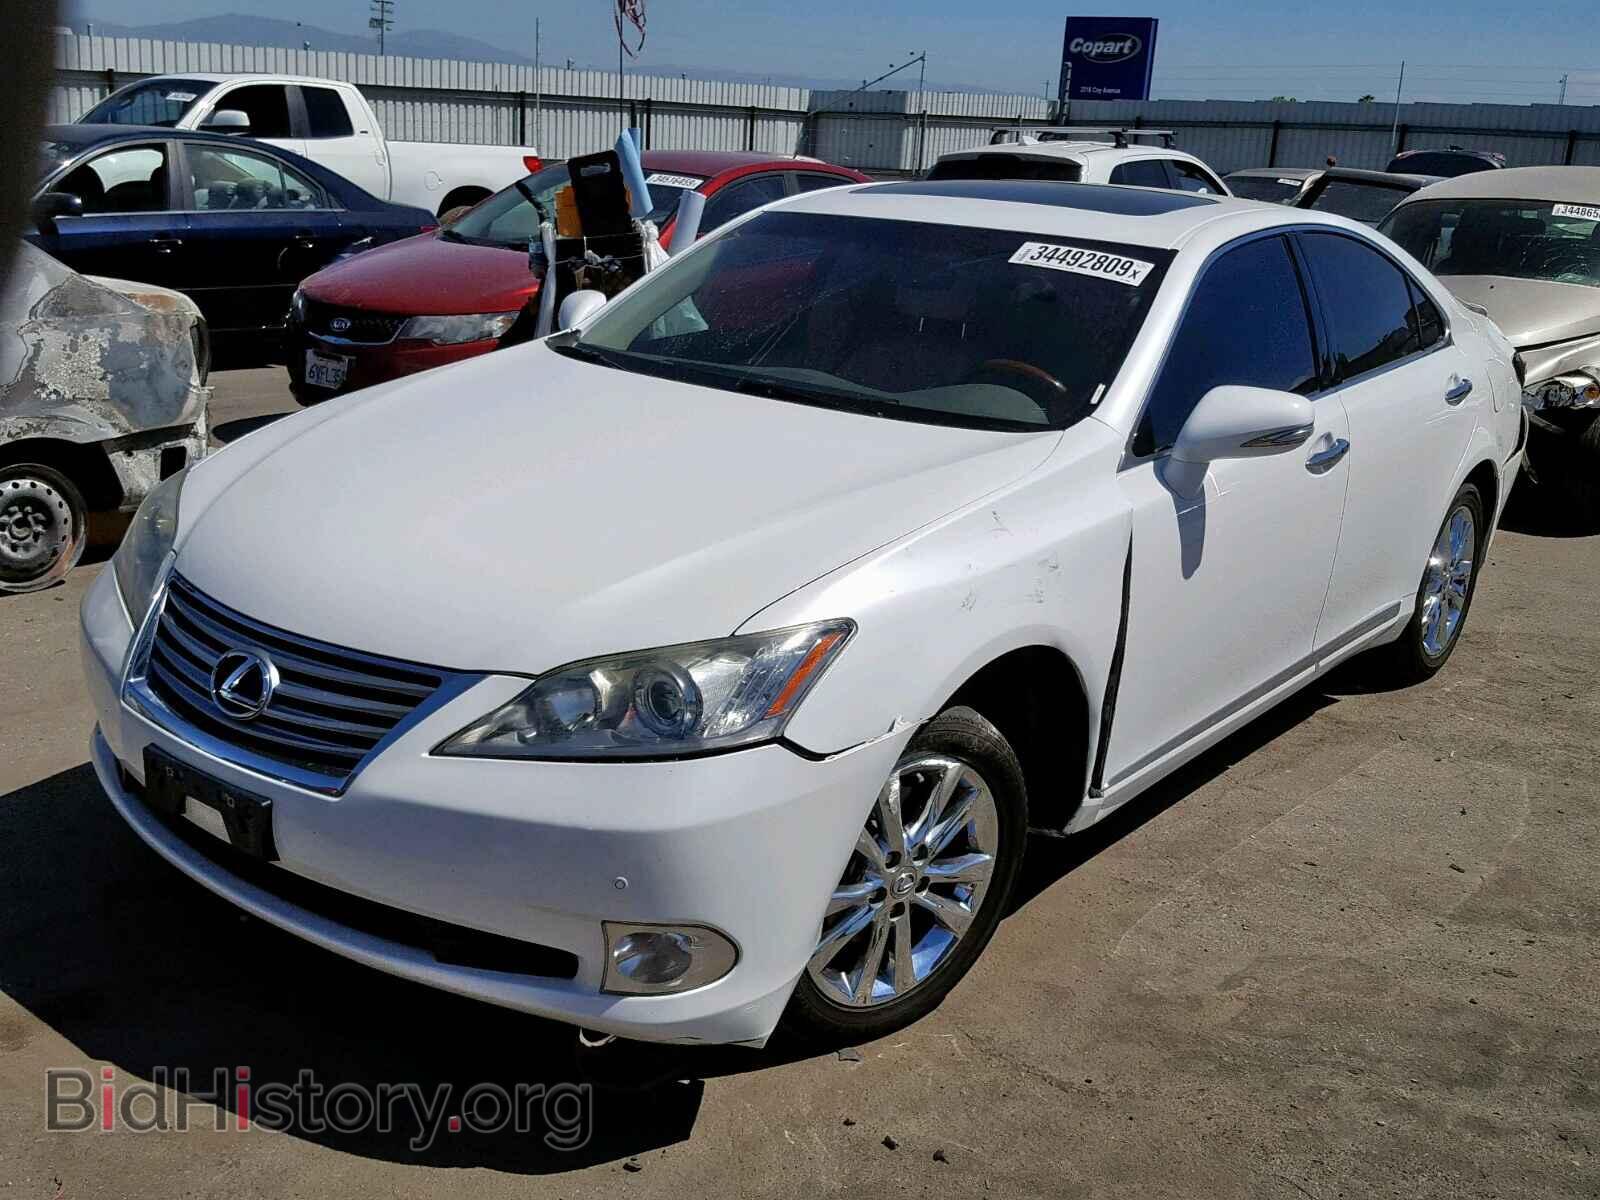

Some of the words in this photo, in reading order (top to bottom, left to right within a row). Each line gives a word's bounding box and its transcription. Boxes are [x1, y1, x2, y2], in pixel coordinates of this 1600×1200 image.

[1070, 37, 1133, 57] Copart
[1561, 205, 1600, 218] 344865
[1030, 245, 1134, 277] 34492809
